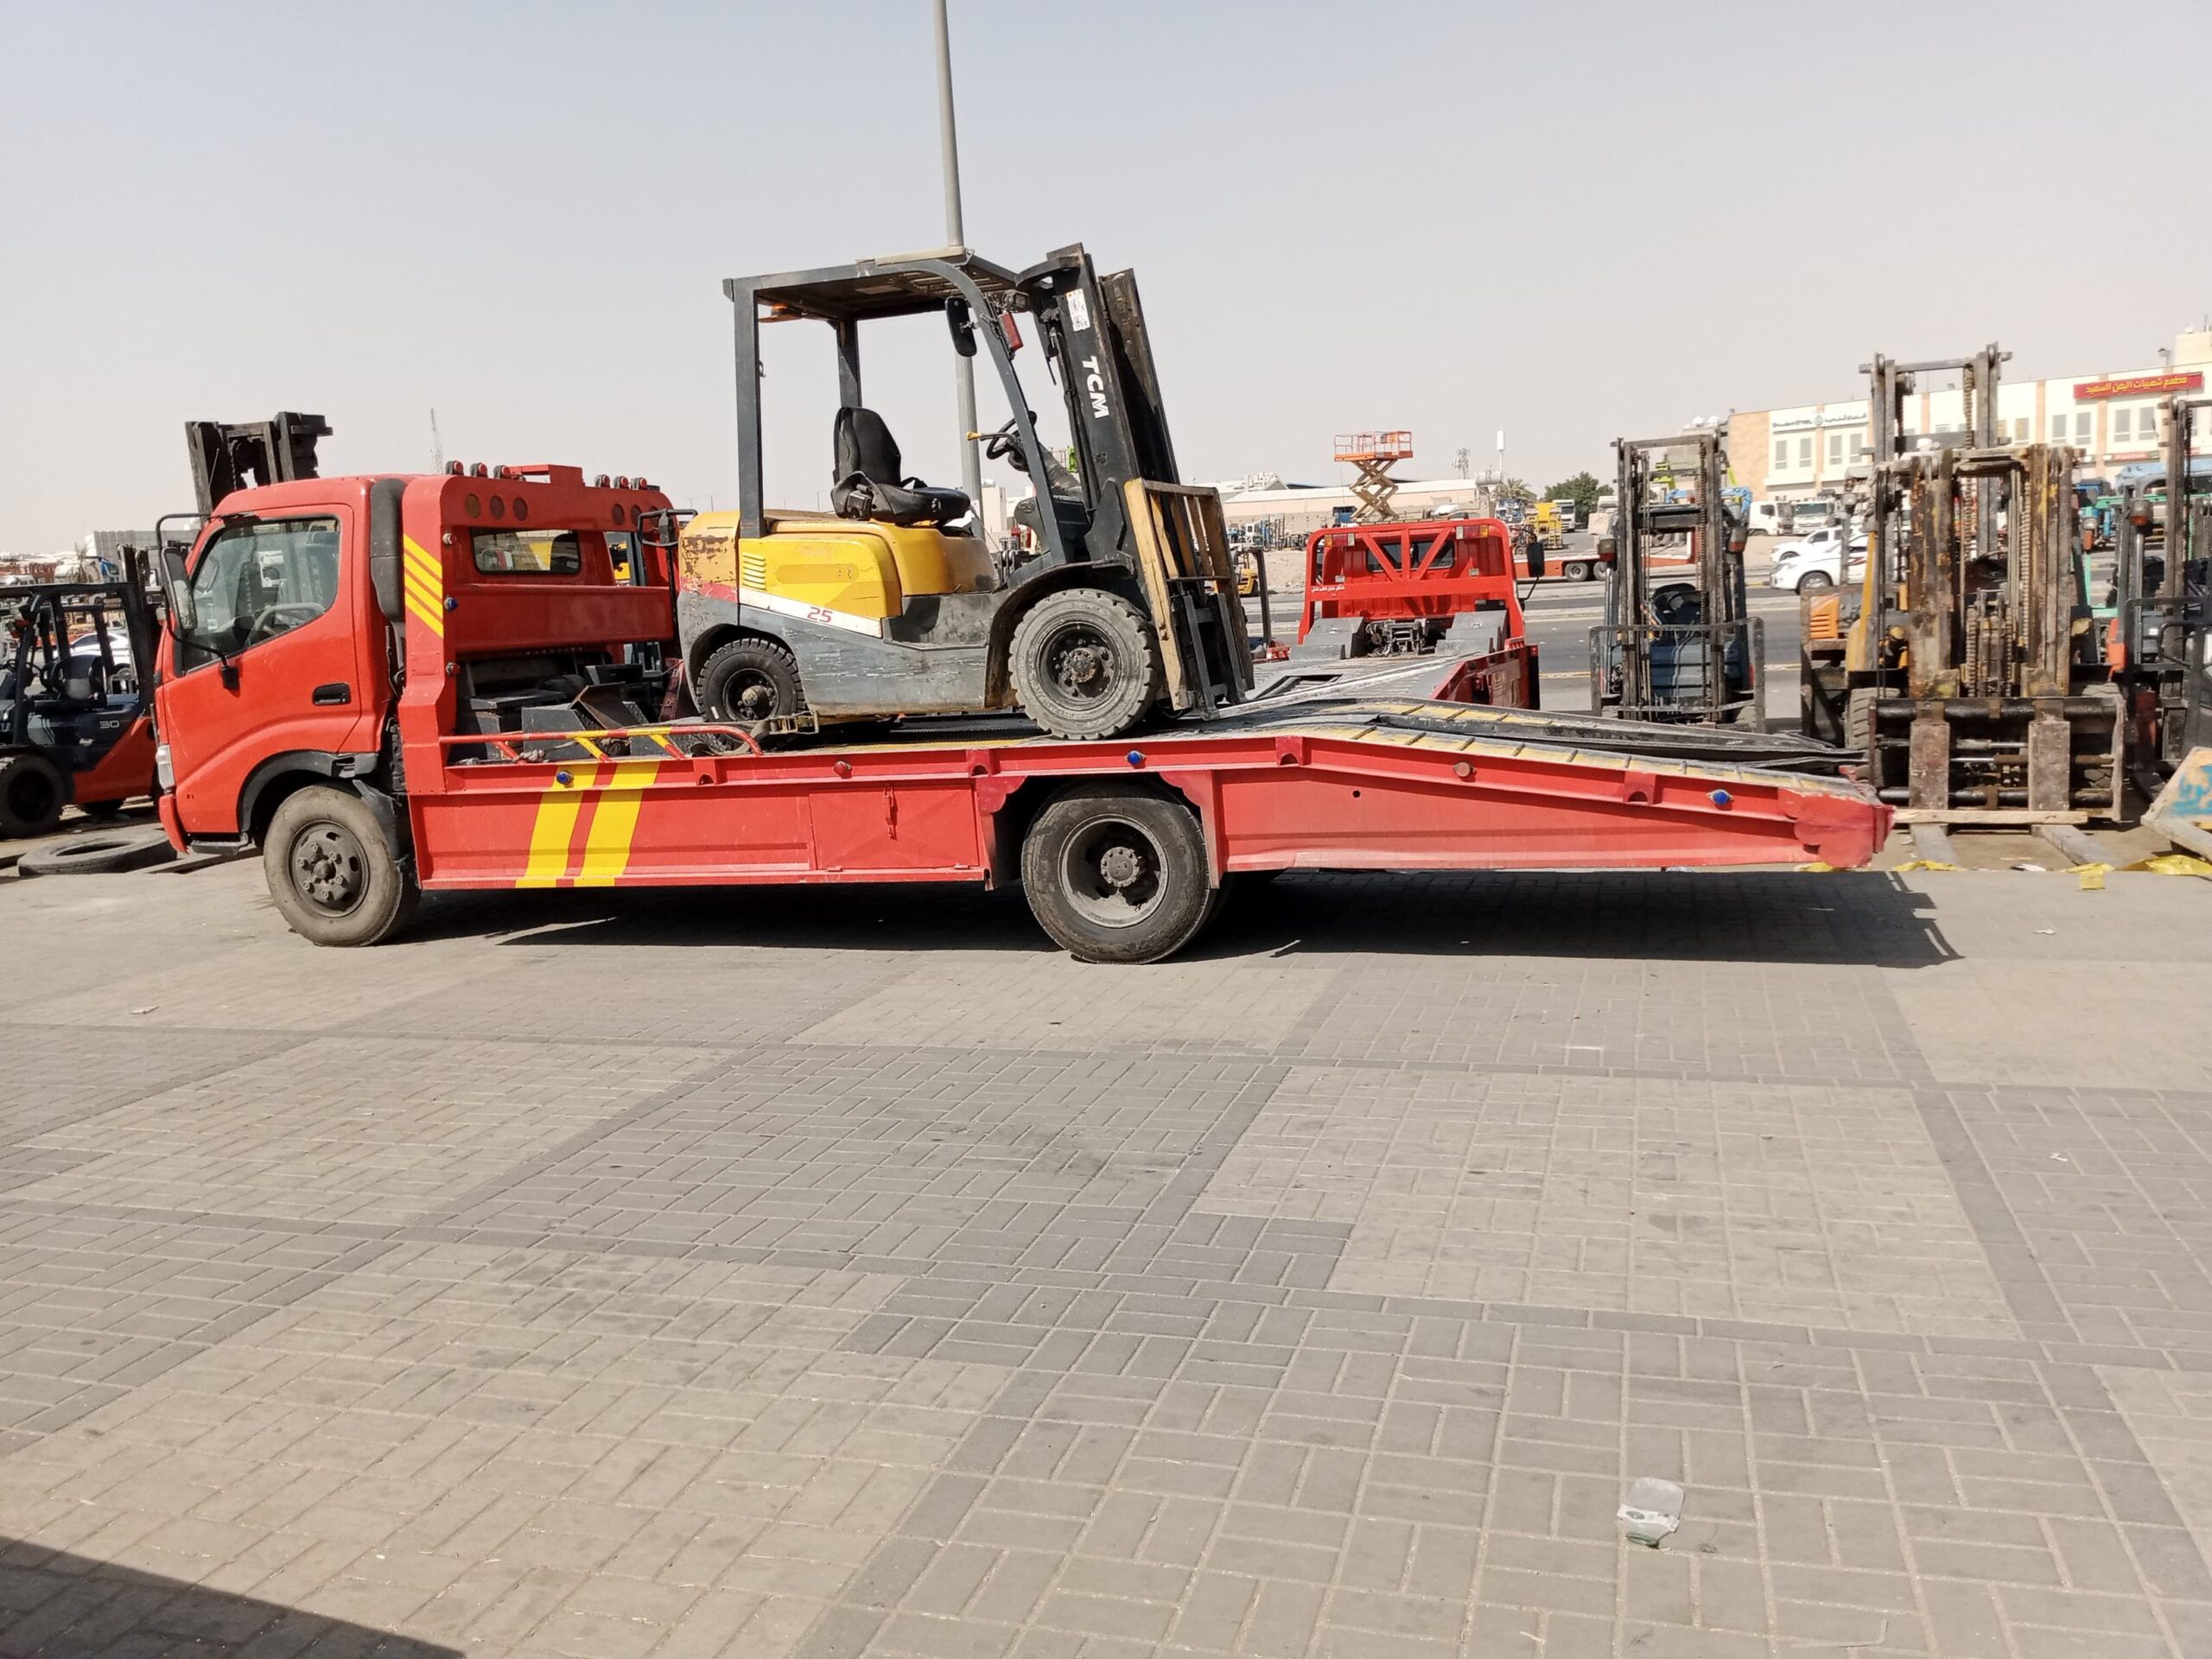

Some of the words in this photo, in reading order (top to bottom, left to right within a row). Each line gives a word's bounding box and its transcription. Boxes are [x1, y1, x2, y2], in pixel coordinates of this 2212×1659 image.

[1082, 355, 1109, 418] TCM
[2084, 382, 2112, 397] السعيد
[2112, 380, 2133, 393] اليمن
[2133, 377, 2163, 391] شعبيات
[2164, 376, 2188, 389] مطعم
[807, 606, 833, 623] 25
[99, 720, 119, 729] 30
